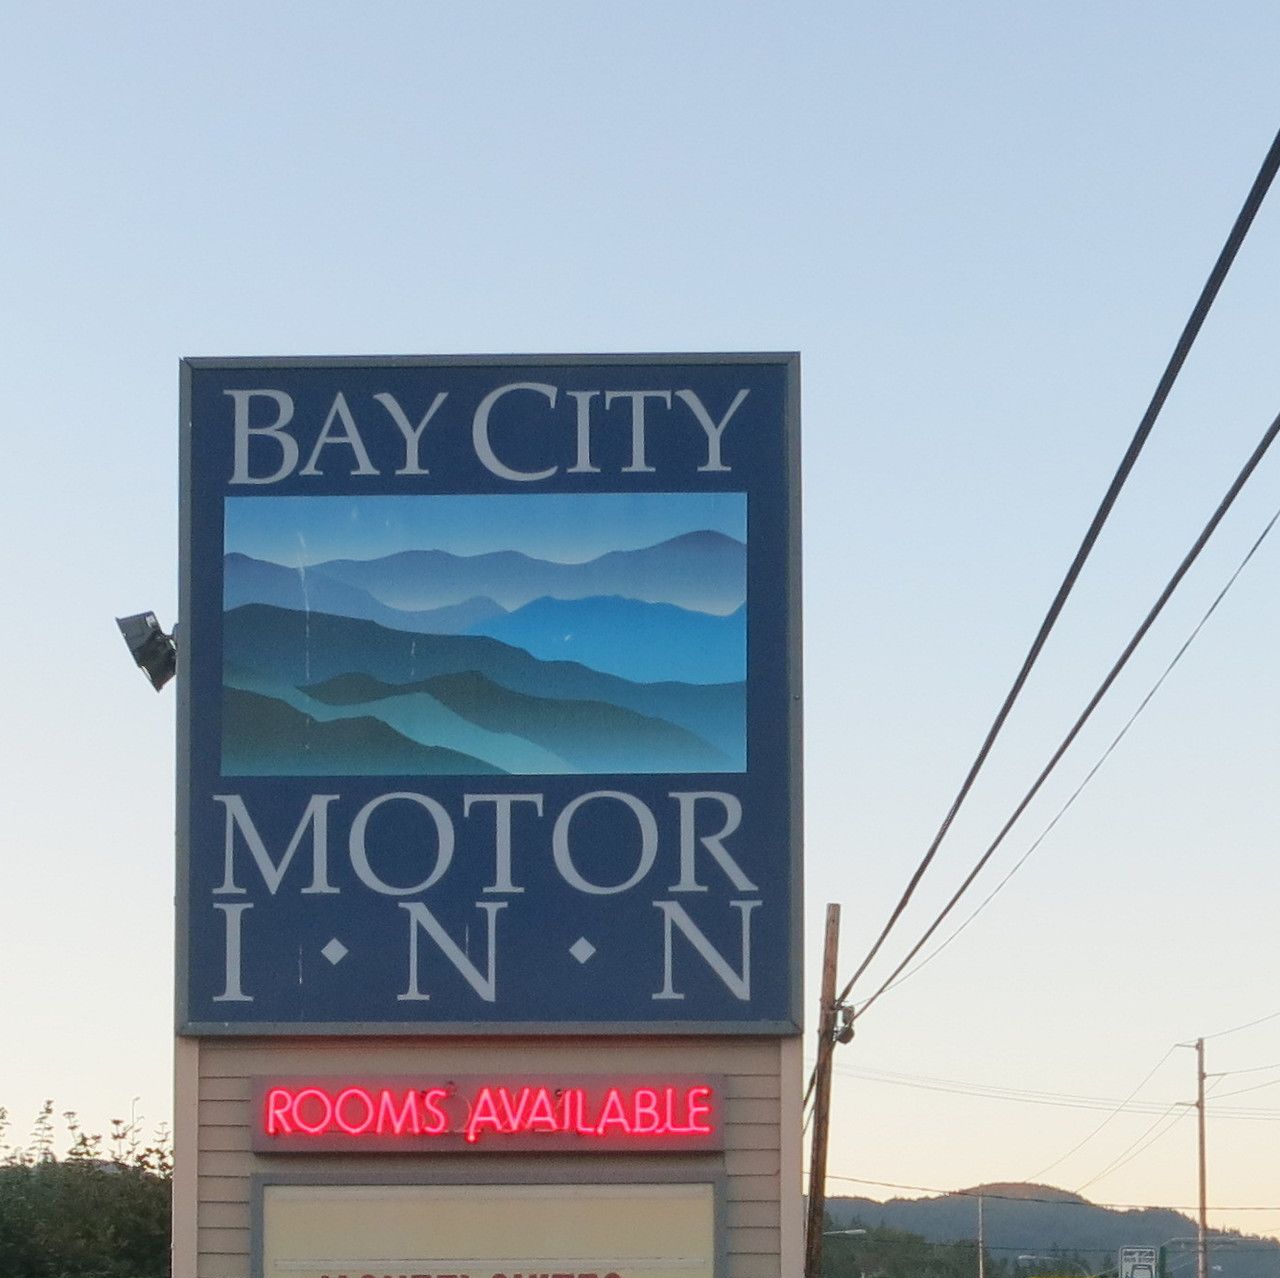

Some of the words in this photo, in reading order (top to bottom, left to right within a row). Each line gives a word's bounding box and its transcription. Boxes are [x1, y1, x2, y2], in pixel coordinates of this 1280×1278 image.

[223, 389, 448, 485] BAY
[472, 382, 750, 482] CITY
[212, 790, 759, 896] MOTOR
[266, 1087, 448, 1137] ROOMS
[467, 1086, 714, 1139] AVAILABLE
